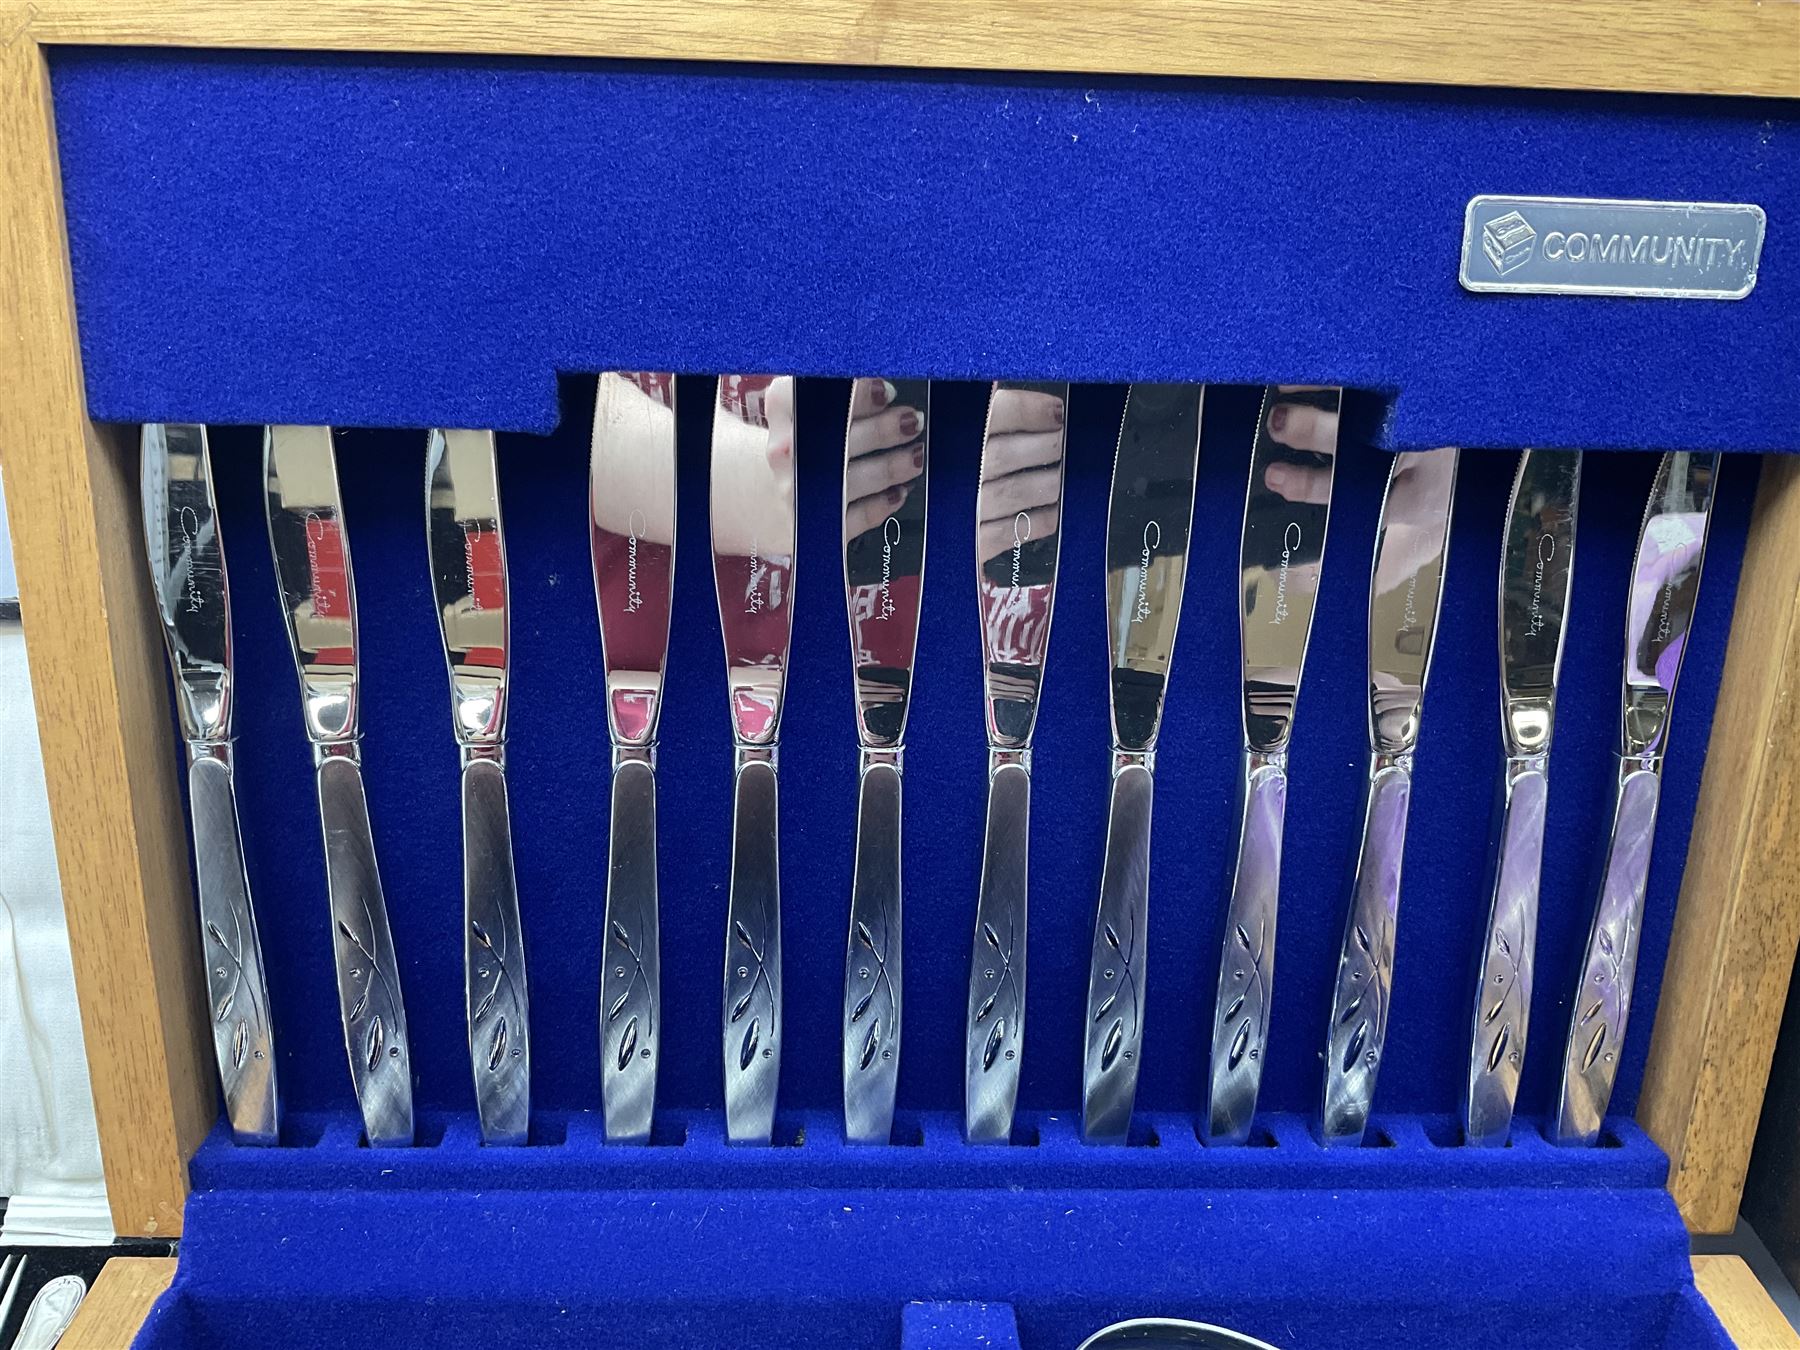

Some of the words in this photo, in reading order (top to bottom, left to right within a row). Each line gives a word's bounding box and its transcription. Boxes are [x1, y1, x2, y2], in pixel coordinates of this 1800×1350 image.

[1542, 231, 1746, 271] COMMUNITY
[623, 508, 645, 614] Community
[875, 516, 900, 622] Community
[1131, 520, 1159, 624] Community
[1269, 522, 1300, 625] Community
[1524, 534, 1554, 637] Community
